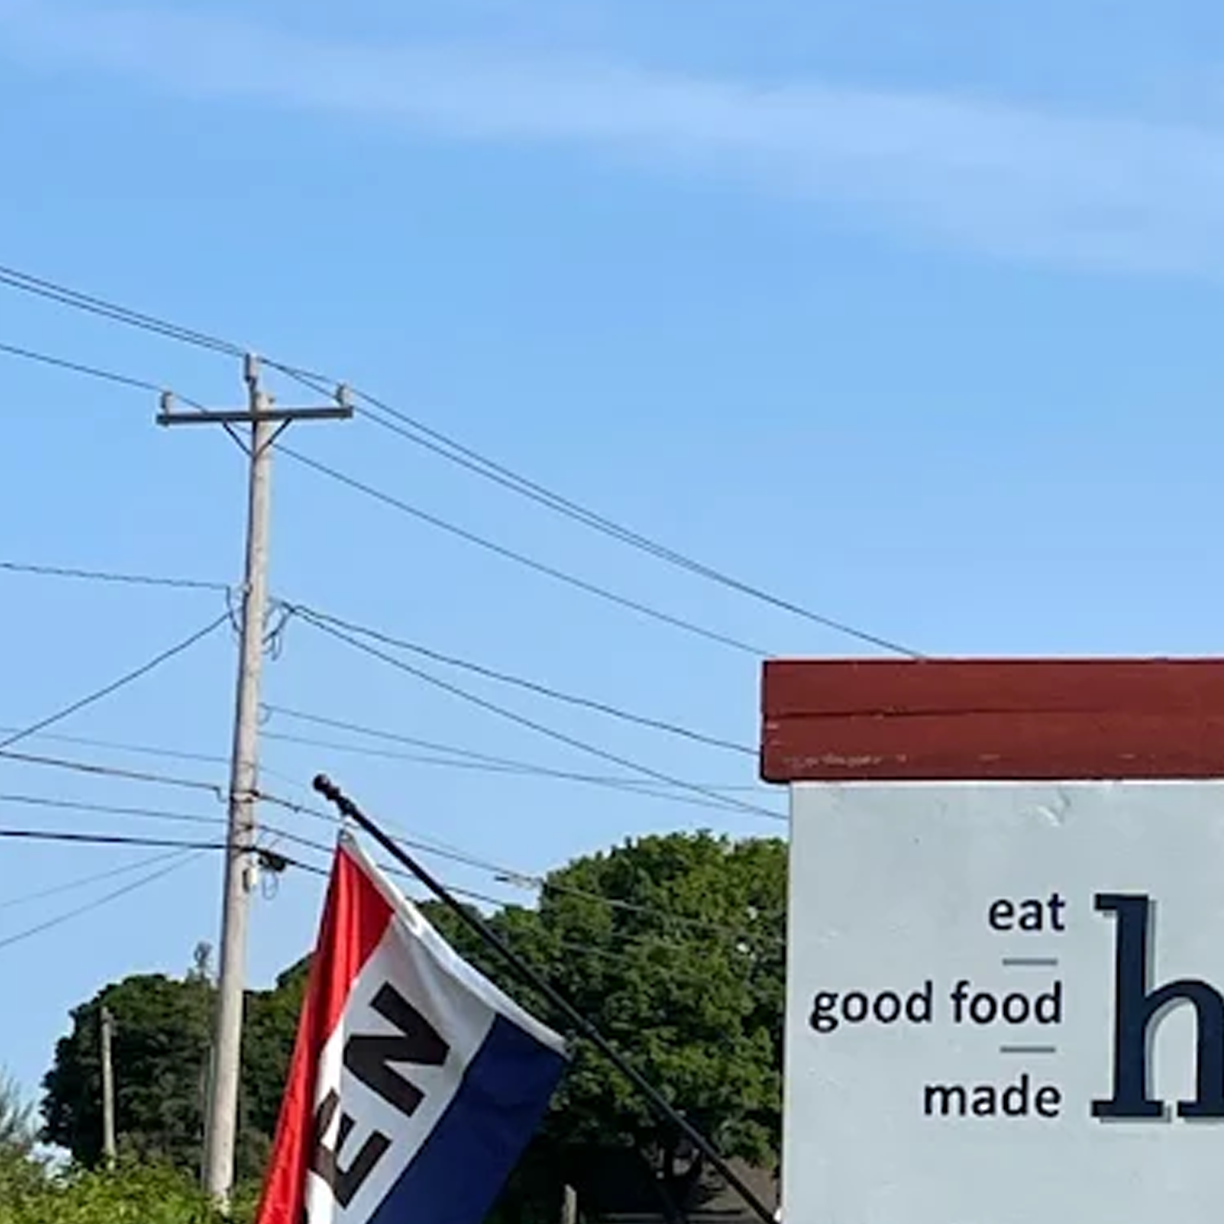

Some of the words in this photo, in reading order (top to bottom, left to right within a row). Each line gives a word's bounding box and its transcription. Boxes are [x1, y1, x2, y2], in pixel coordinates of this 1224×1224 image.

[988, 892, 1066, 932] eat
[809, 979, 933, 1034] good
[950, 979, 1062, 1025] food
[924, 1074, 1062, 1118] made
